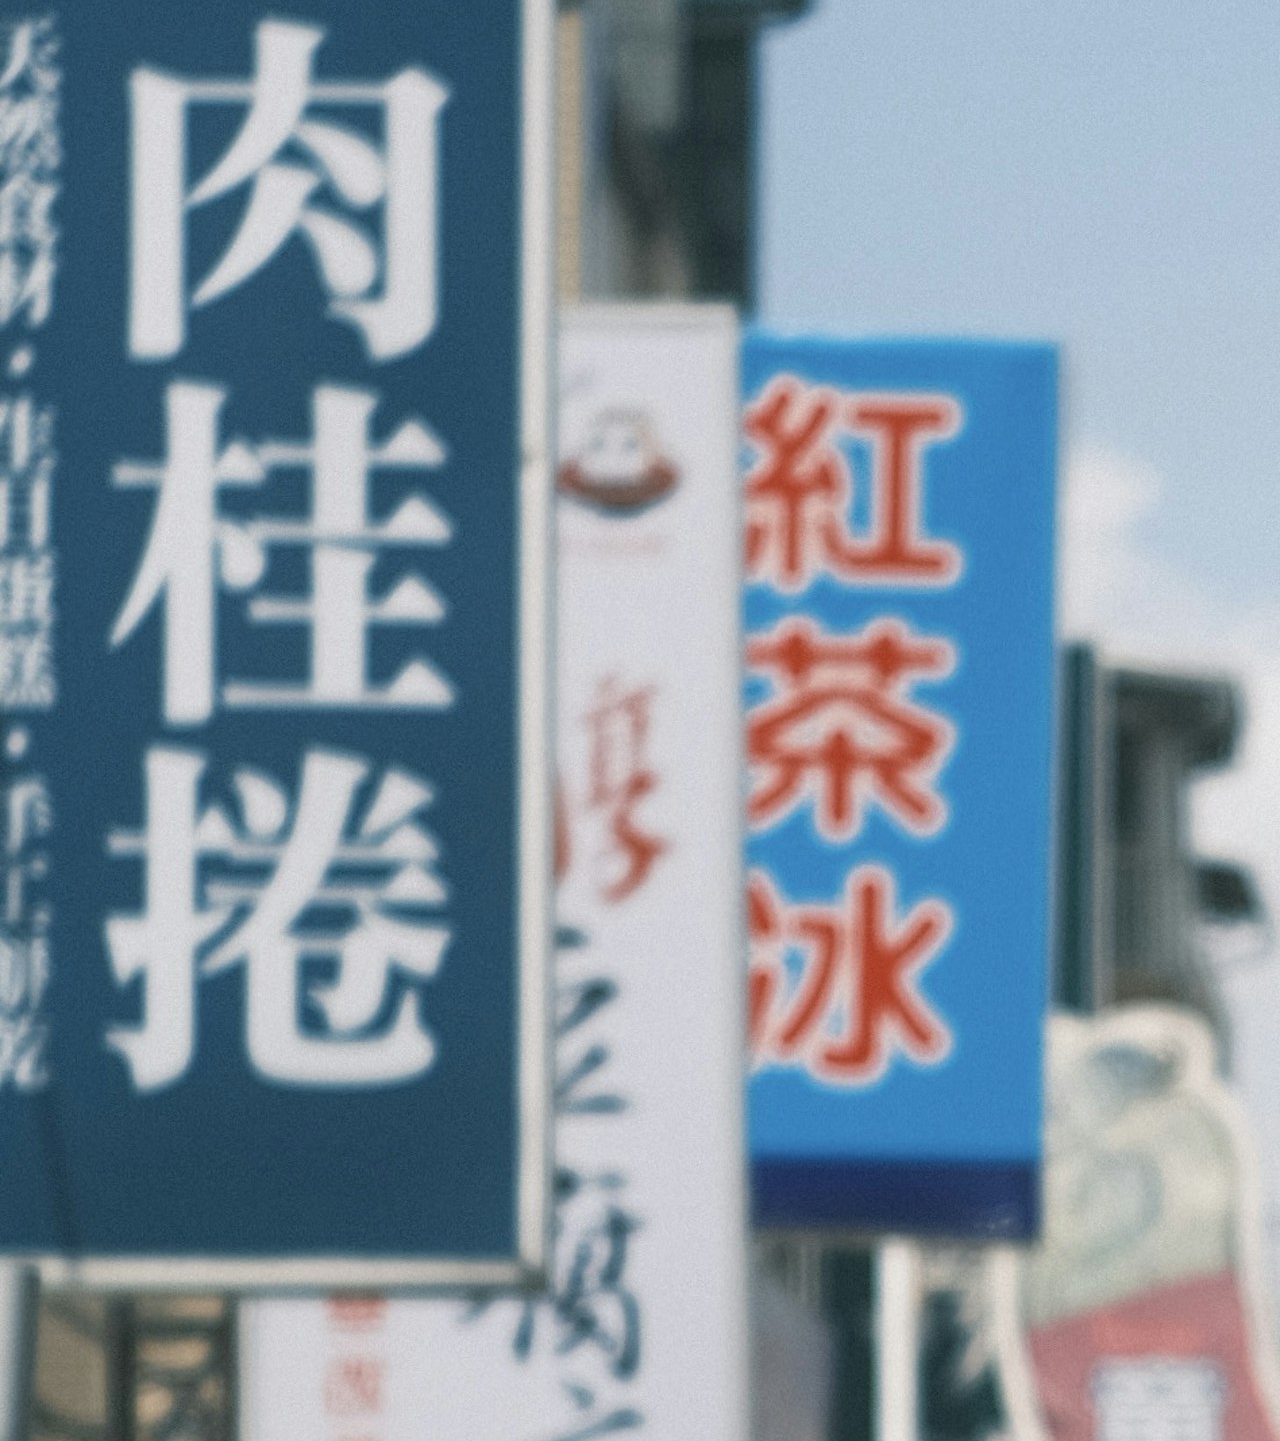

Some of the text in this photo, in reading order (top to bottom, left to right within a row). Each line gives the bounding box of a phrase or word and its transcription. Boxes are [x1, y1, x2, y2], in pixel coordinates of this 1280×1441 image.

[105, 16, 456, 1093] 肉桂捲
[743, 371, 966, 1083] 紅茶冰
